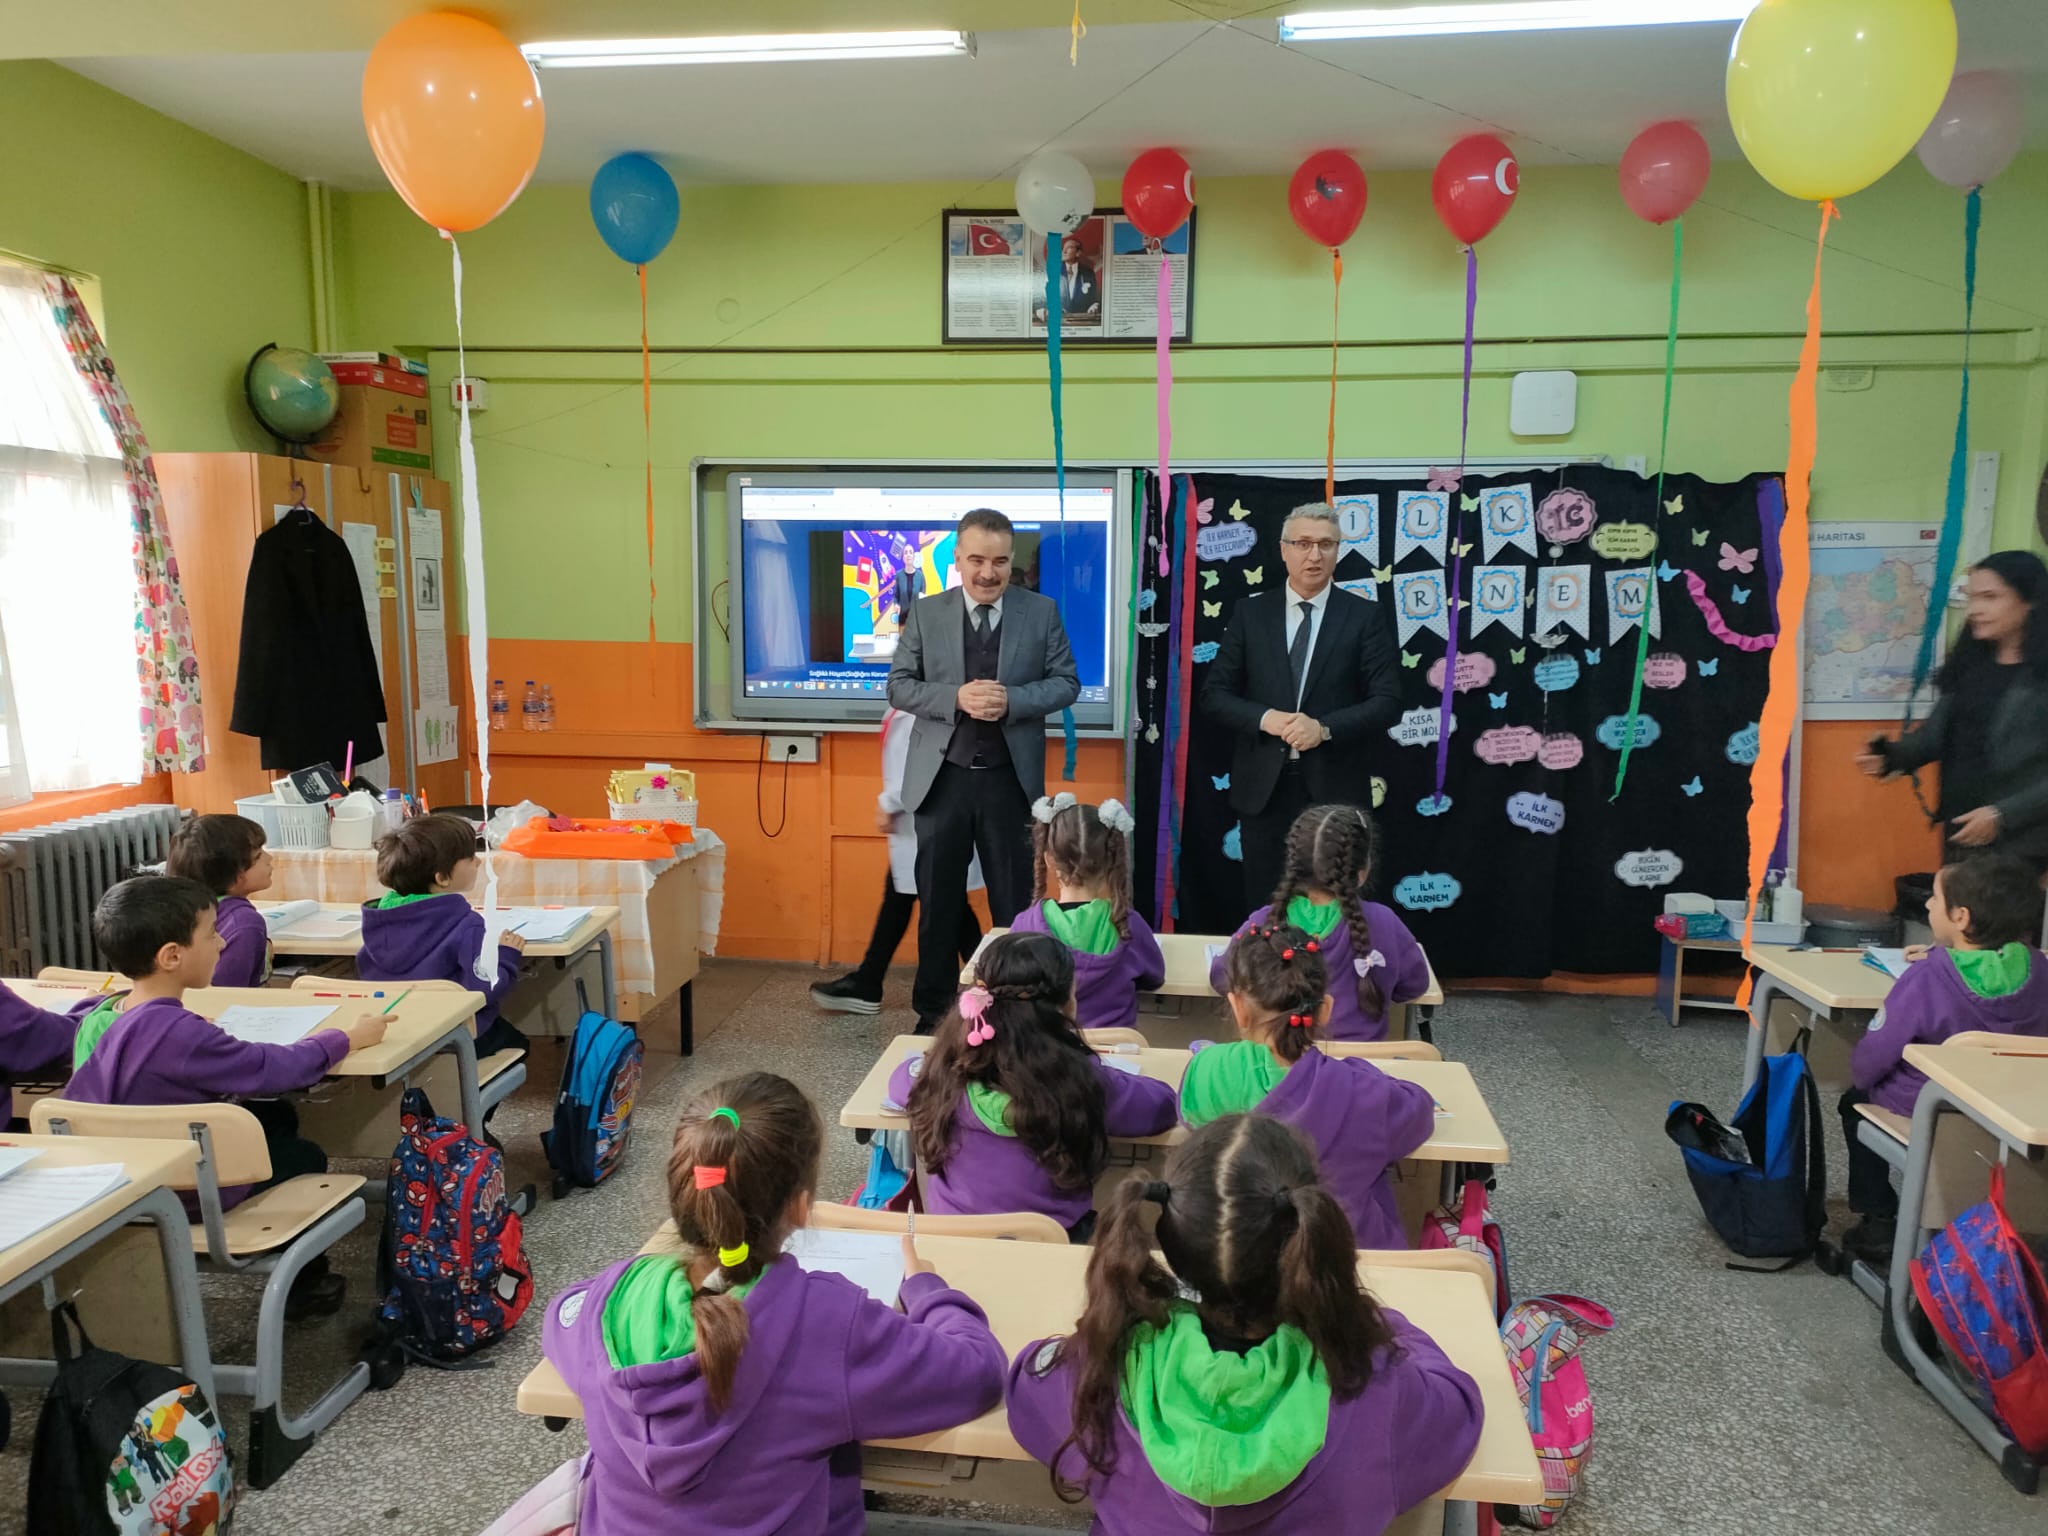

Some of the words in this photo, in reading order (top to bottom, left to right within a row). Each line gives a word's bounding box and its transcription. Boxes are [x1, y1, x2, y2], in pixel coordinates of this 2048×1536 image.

[1816, 530, 1865, 542] HARİTASI
[1409, 714, 1434, 726] KISA
[1401, 728, 1419, 740] BİR
[1421, 727, 1441, 738] MOL
[1531, 800, 1548, 813] İLK
[1517, 810, 1557, 829] KARNEM
[1419, 880, 1435, 892] İLK
[1409, 893, 1449, 904] KARNEM
[150, 1436, 224, 1523] ROBLOX
